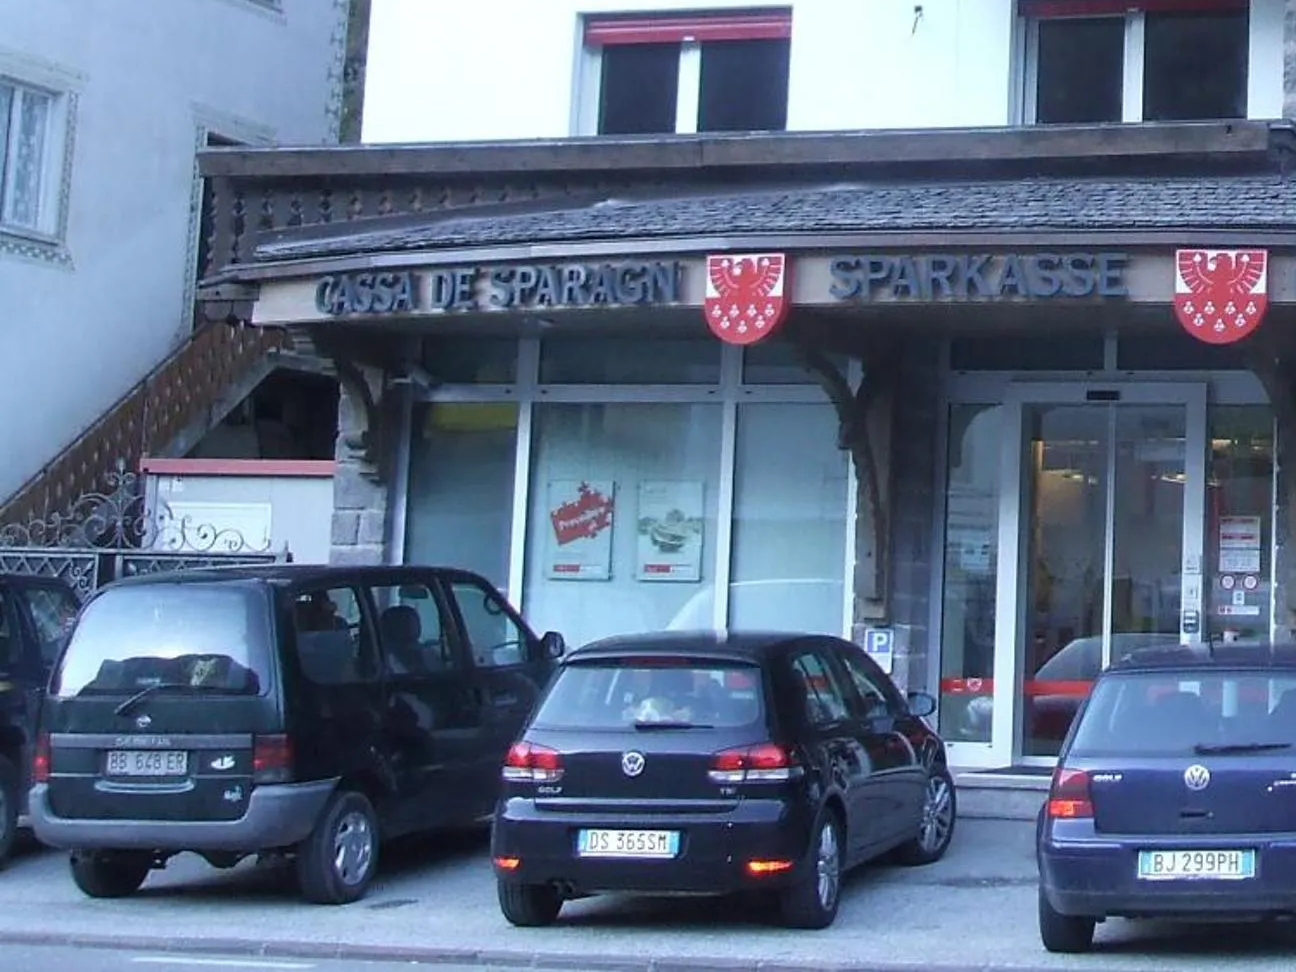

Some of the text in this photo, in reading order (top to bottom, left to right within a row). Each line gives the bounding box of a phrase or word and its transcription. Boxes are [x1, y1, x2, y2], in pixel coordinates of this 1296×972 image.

[828, 253, 1131, 300] SPARKASSE
[315, 261, 679, 315] CASSA DE SPARAGN
[873, 632, 888, 652] P
[167, 753, 184, 770] ER
[590, 832, 609, 850] DS
[1154, 852, 1239, 872] BJ 299PH
